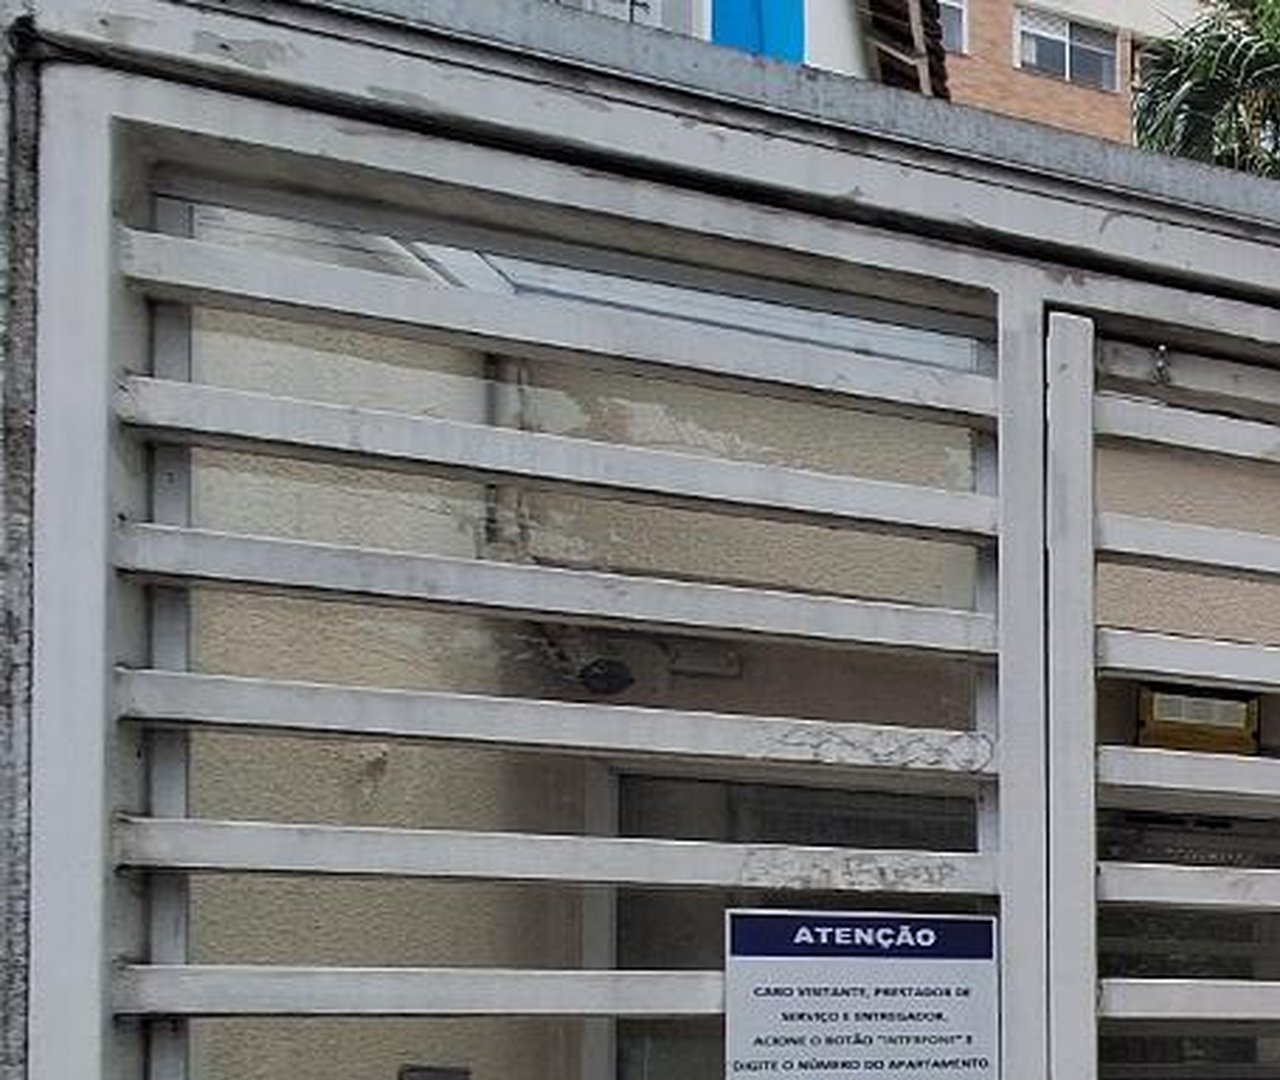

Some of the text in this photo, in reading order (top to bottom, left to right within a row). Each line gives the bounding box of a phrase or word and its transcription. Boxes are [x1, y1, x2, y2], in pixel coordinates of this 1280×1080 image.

[793, 925, 937, 949] ATENÇÃO
[753, 986, 794, 999] CARO
[873, 986, 952, 999] PRESTADOR
[780, 1011, 840, 1024] SERVIÇO
[753, 1036, 806, 1048] ACIONE
[809, 1036, 822, 1047] O
[824, 1033, 874, 1047] BOTÃO
[732, 1060, 778, 1073] DIGITE
[781, 1061, 795, 1072] O
[797, 1058, 861, 1072] NÚMERO
[863, 1060, 885, 1071] DO
